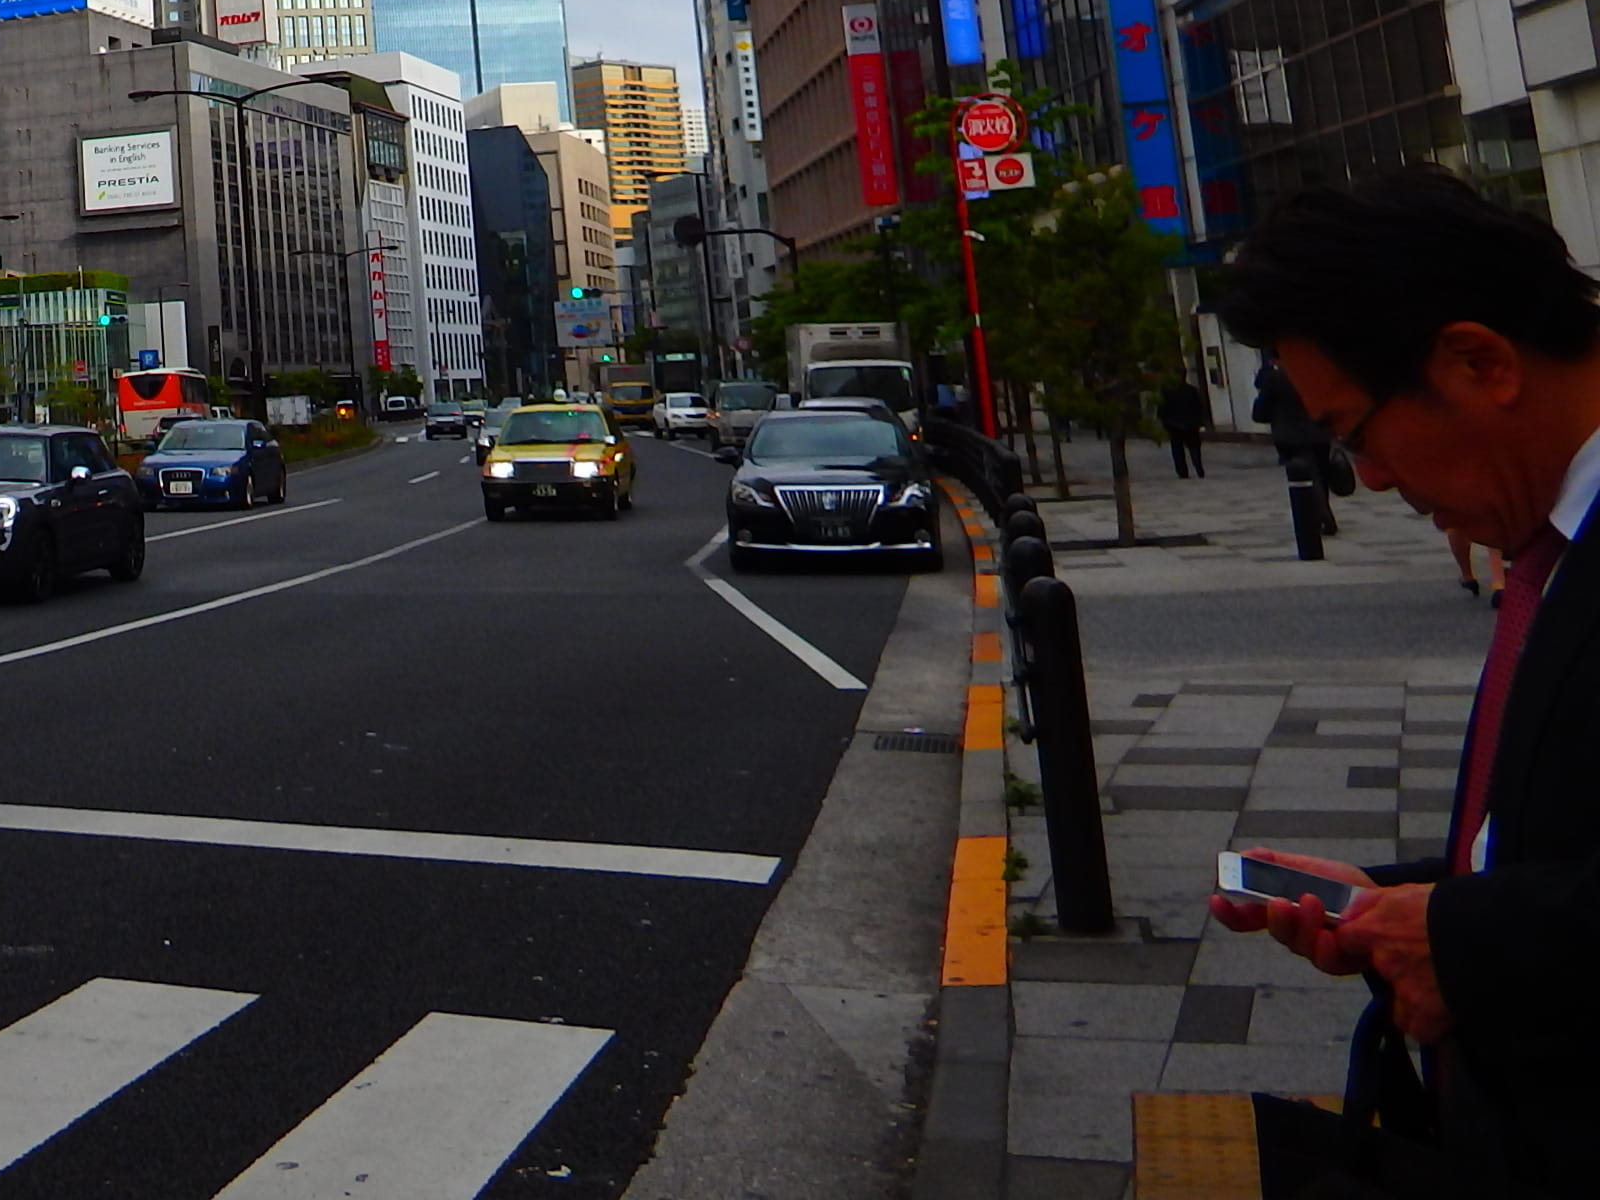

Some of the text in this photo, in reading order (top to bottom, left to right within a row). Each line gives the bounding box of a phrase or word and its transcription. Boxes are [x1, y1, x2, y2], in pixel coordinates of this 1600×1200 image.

[967, 116, 1011, 136] 消火栓
[94, 141, 160, 155] Banking Services
[110, 152, 146, 165] in English
